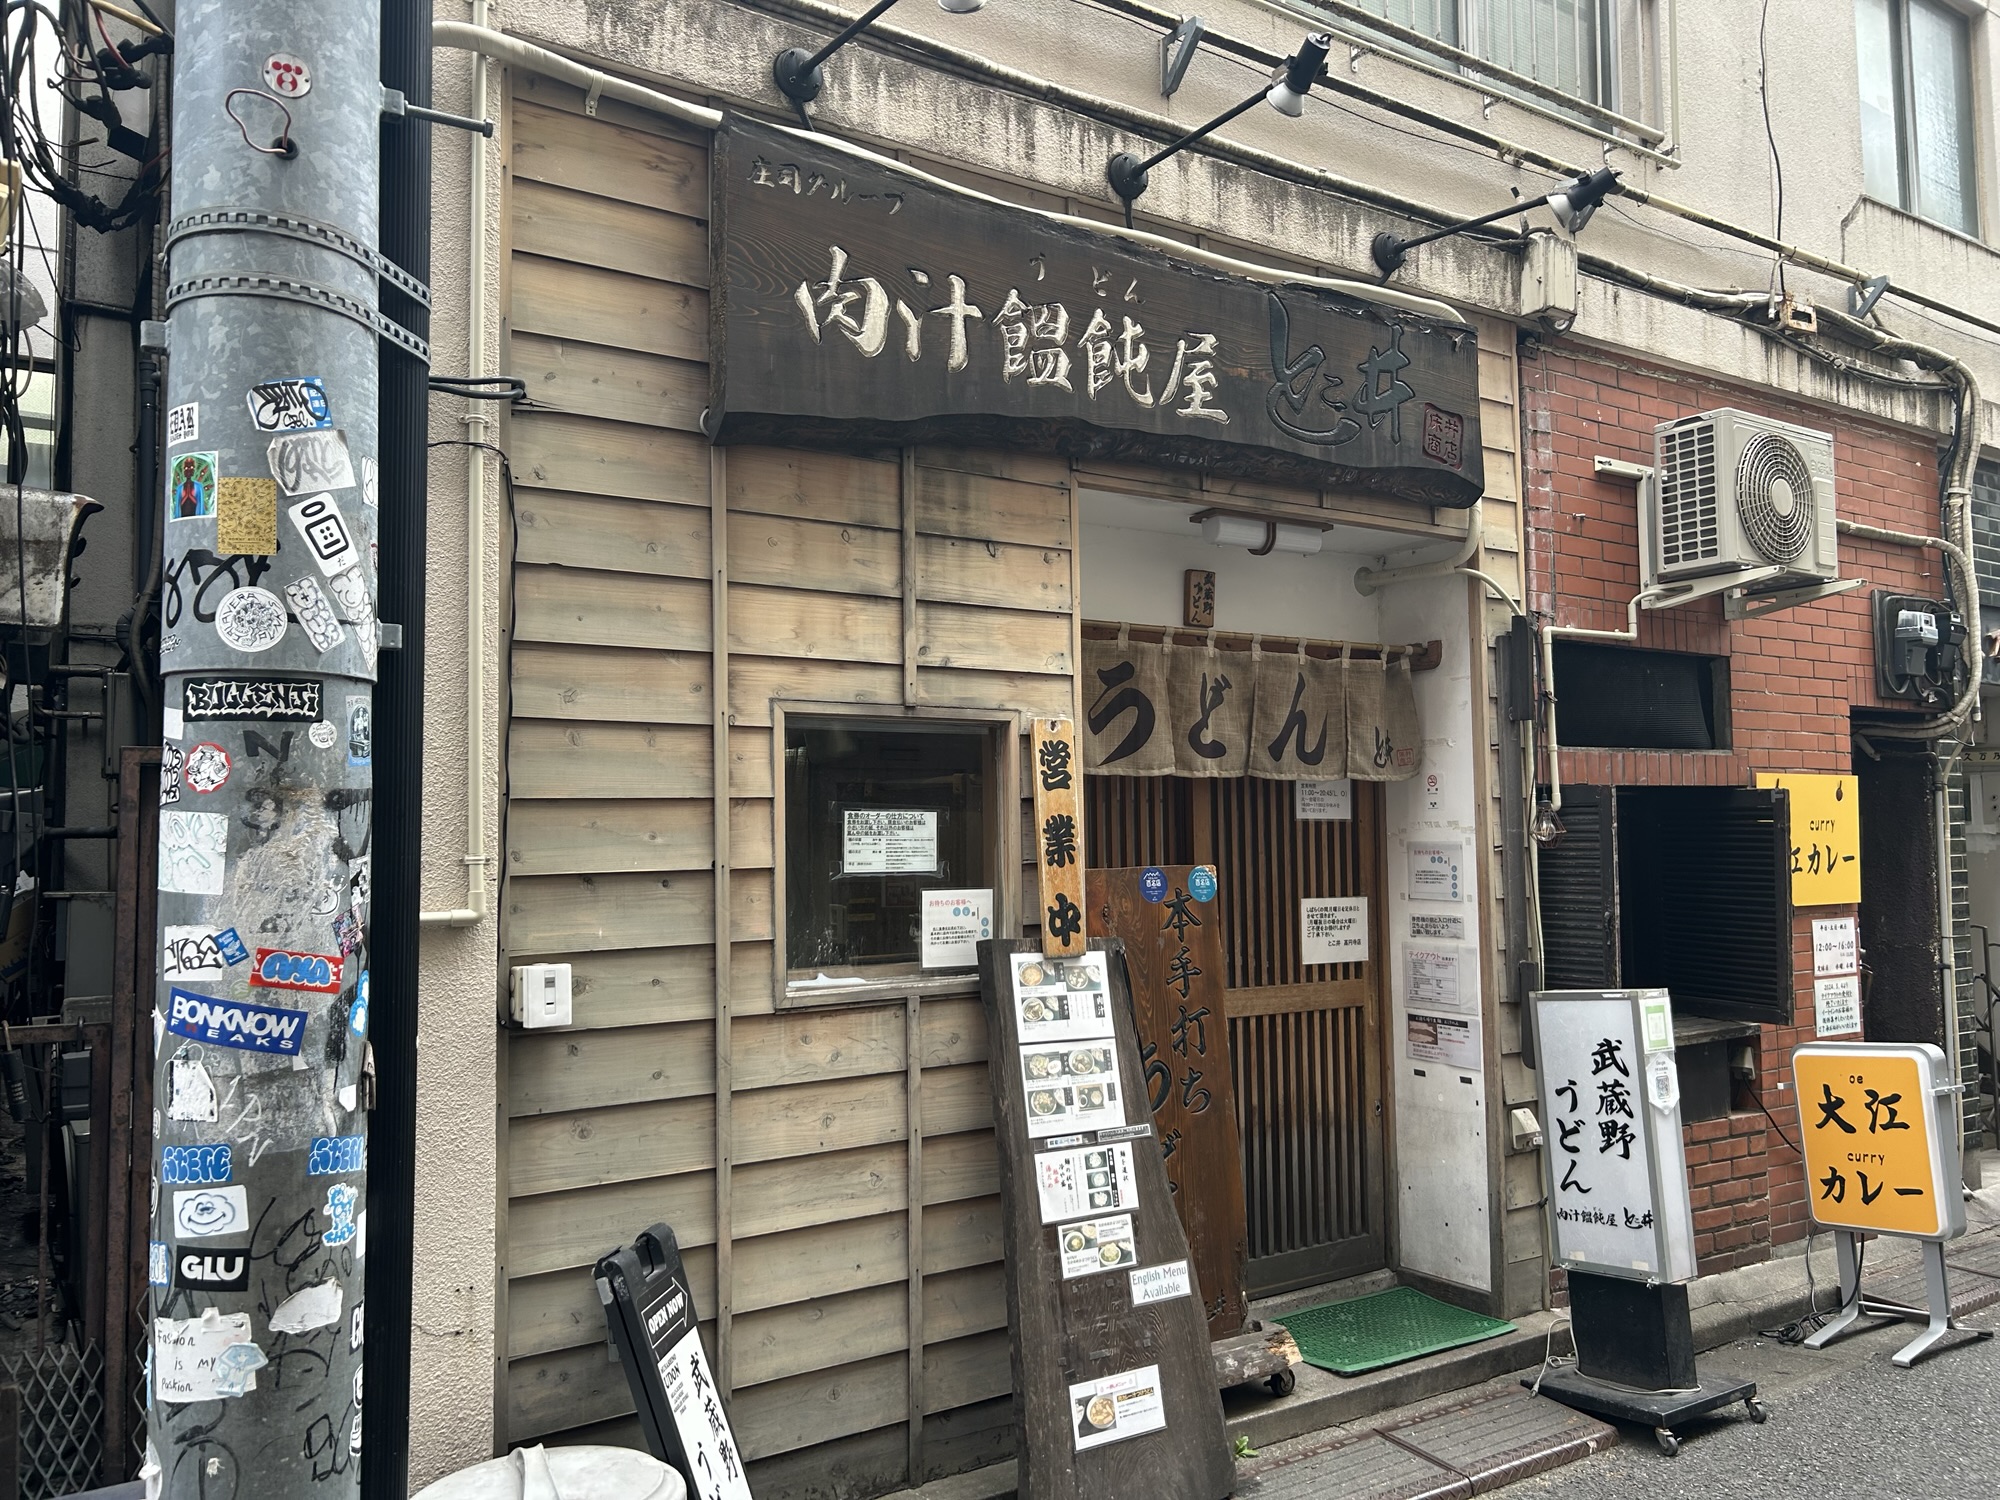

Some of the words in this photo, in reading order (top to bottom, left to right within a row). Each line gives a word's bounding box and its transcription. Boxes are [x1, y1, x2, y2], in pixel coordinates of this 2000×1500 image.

[1028, 252, 1146, 304] うどん
[793, 244, 1231, 426] 肉汁饂飩屋
[1088, 660, 1329, 768] うどん
[1039, 739, 1082, 948] 営業中
[1809, 819, 1836, 833] curry
[1408, 950, 1441, 961] テイクアウト
[172, 995, 300, 1039] BONKNOW
[1160, 887, 1212, 1117] 本手打ち
[1591, 1037, 1637, 1161] 武蔵野
[1815, 1083, 1911, 1135] 大江
[1555, 1078, 1593, 1194] うどん
[1847, 1151, 1885, 1165] curry
[1818, 1166, 1924, 1206] カレー
[1556, 1202, 1619, 1227] 肉汁饂飩屋
[180, 1254, 245, 1282] GLU
[1131, 1269, 1161, 1286] English
[1162, 1266, 1187, 1279] Menu
[648, 1306, 669, 1335] OPEN
[665, 1291, 684, 1319] NOW
[1142, 1282, 1181, 1300] Available
[174, 1356, 184, 1371] is
[663, 1362, 682, 1390] UDON
[690, 1351, 739, 1484] 武蔵野
